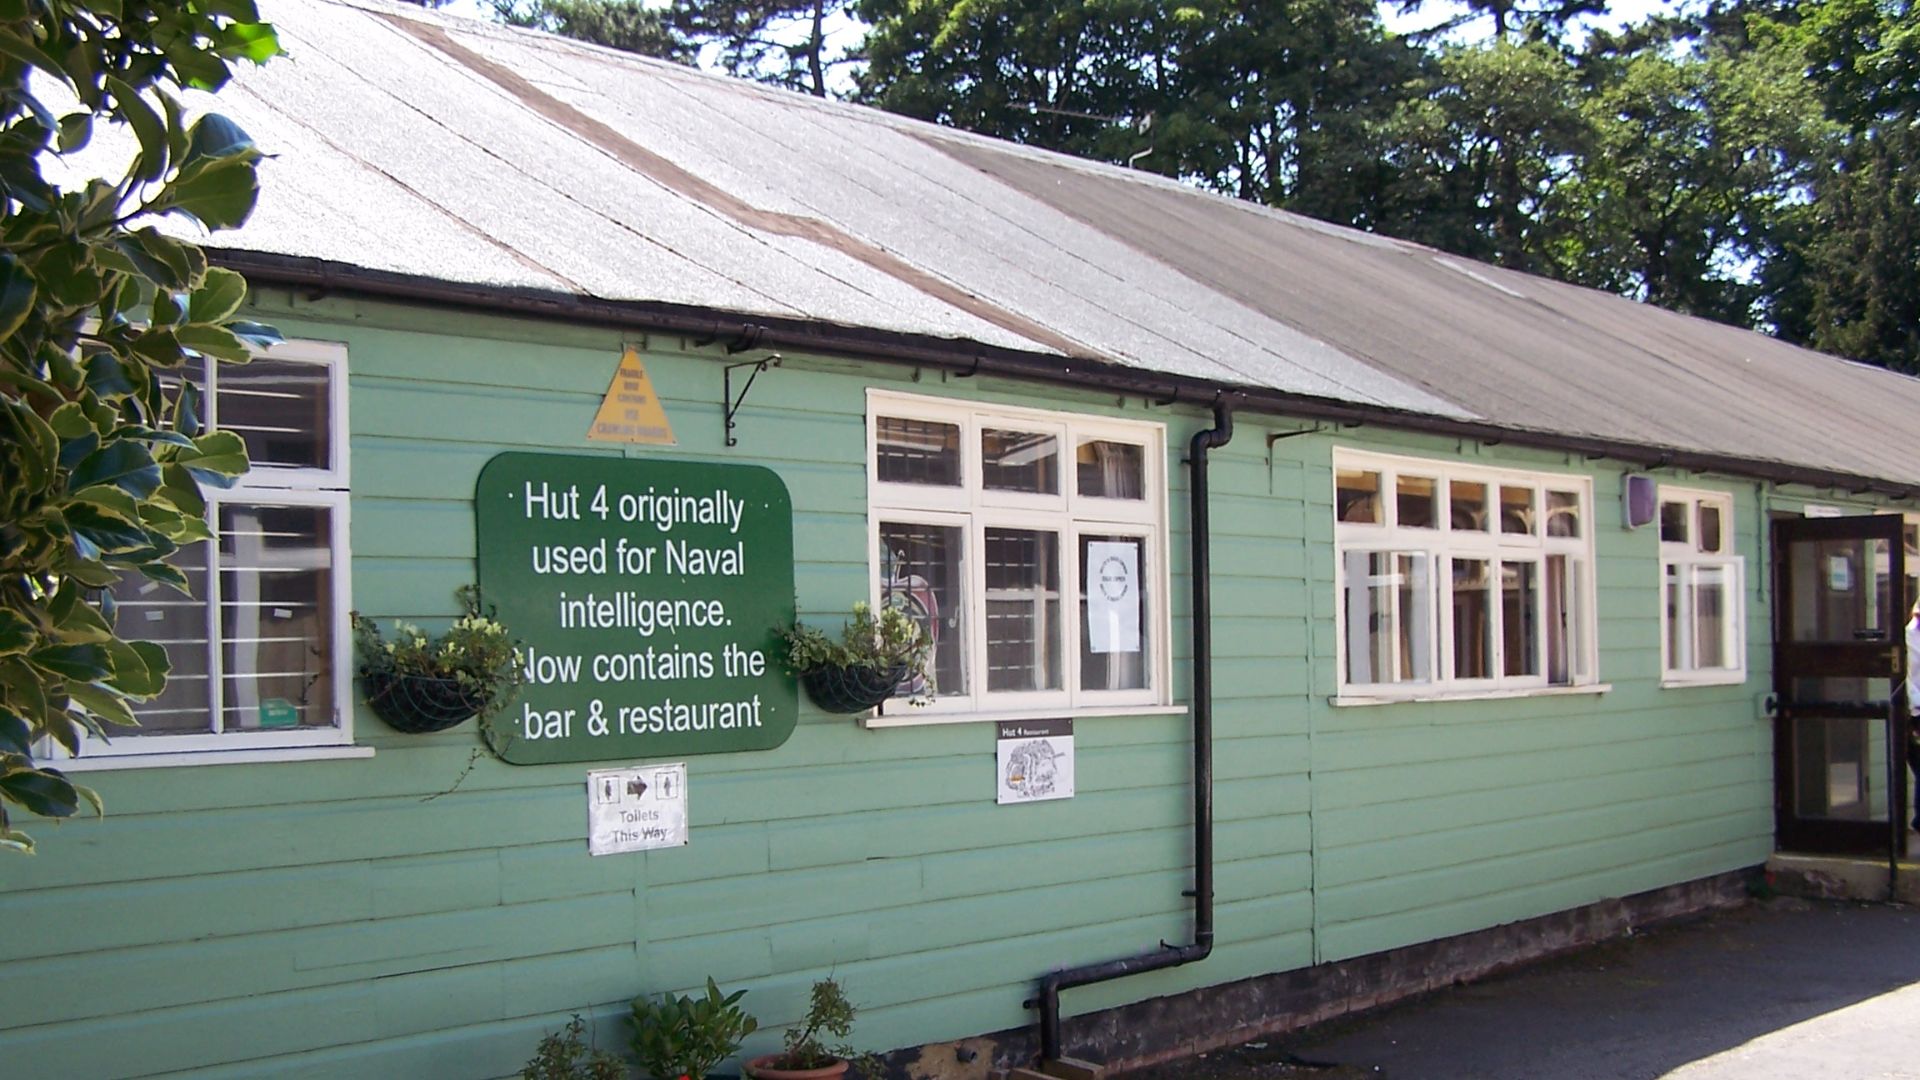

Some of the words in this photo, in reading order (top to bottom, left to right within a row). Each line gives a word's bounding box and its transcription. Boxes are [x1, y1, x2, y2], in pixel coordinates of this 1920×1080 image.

[525, 481, 580, 520] Hut
[590, 484, 609, 520] 4
[619, 487, 744, 533] originally
[533, 538, 606, 574] used
[616, 538, 656, 574] for
[666, 540, 744, 575] Naval
[560, 592, 732, 636] intelligence.
[593, 644, 713, 682] contains
[723, 643, 765, 677] the
[524, 703, 576, 739] bar
[587, 699, 610, 736] &
[619, 695, 762, 734] restaurant
[1002, 727, 1016, 737] Hut
[1017, 726, 1022, 736] 4
[612, 829, 639, 843] This
[641, 826, 667, 841] Way
[620, 809, 659, 823] Toilets
